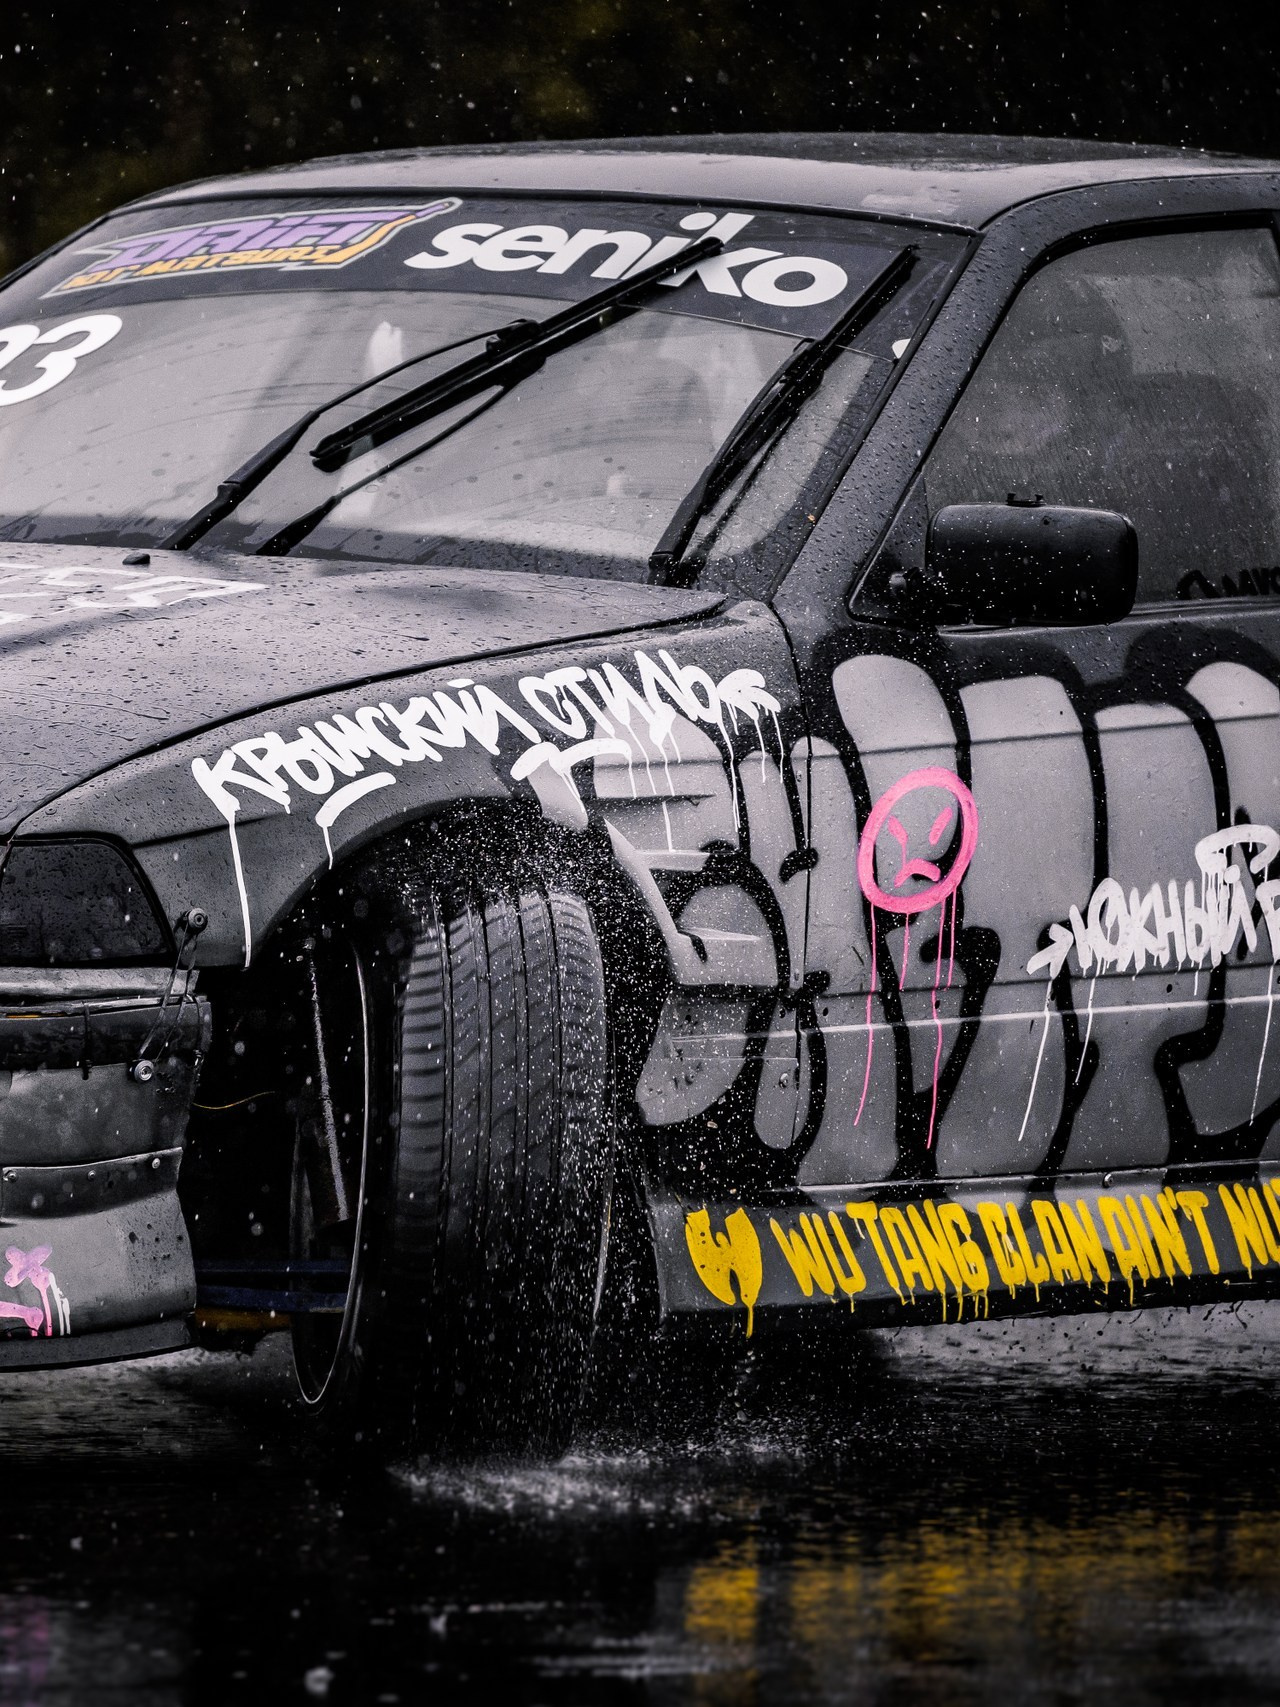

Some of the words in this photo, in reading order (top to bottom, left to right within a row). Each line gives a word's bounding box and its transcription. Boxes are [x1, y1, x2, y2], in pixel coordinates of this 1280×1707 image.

[770, 1210, 866, 1298] WU
[846, 1199, 991, 1306] TANG
[1097, 1187, 1220, 1290] AIN'T
[1218, 1178, 1280, 1270] NU
